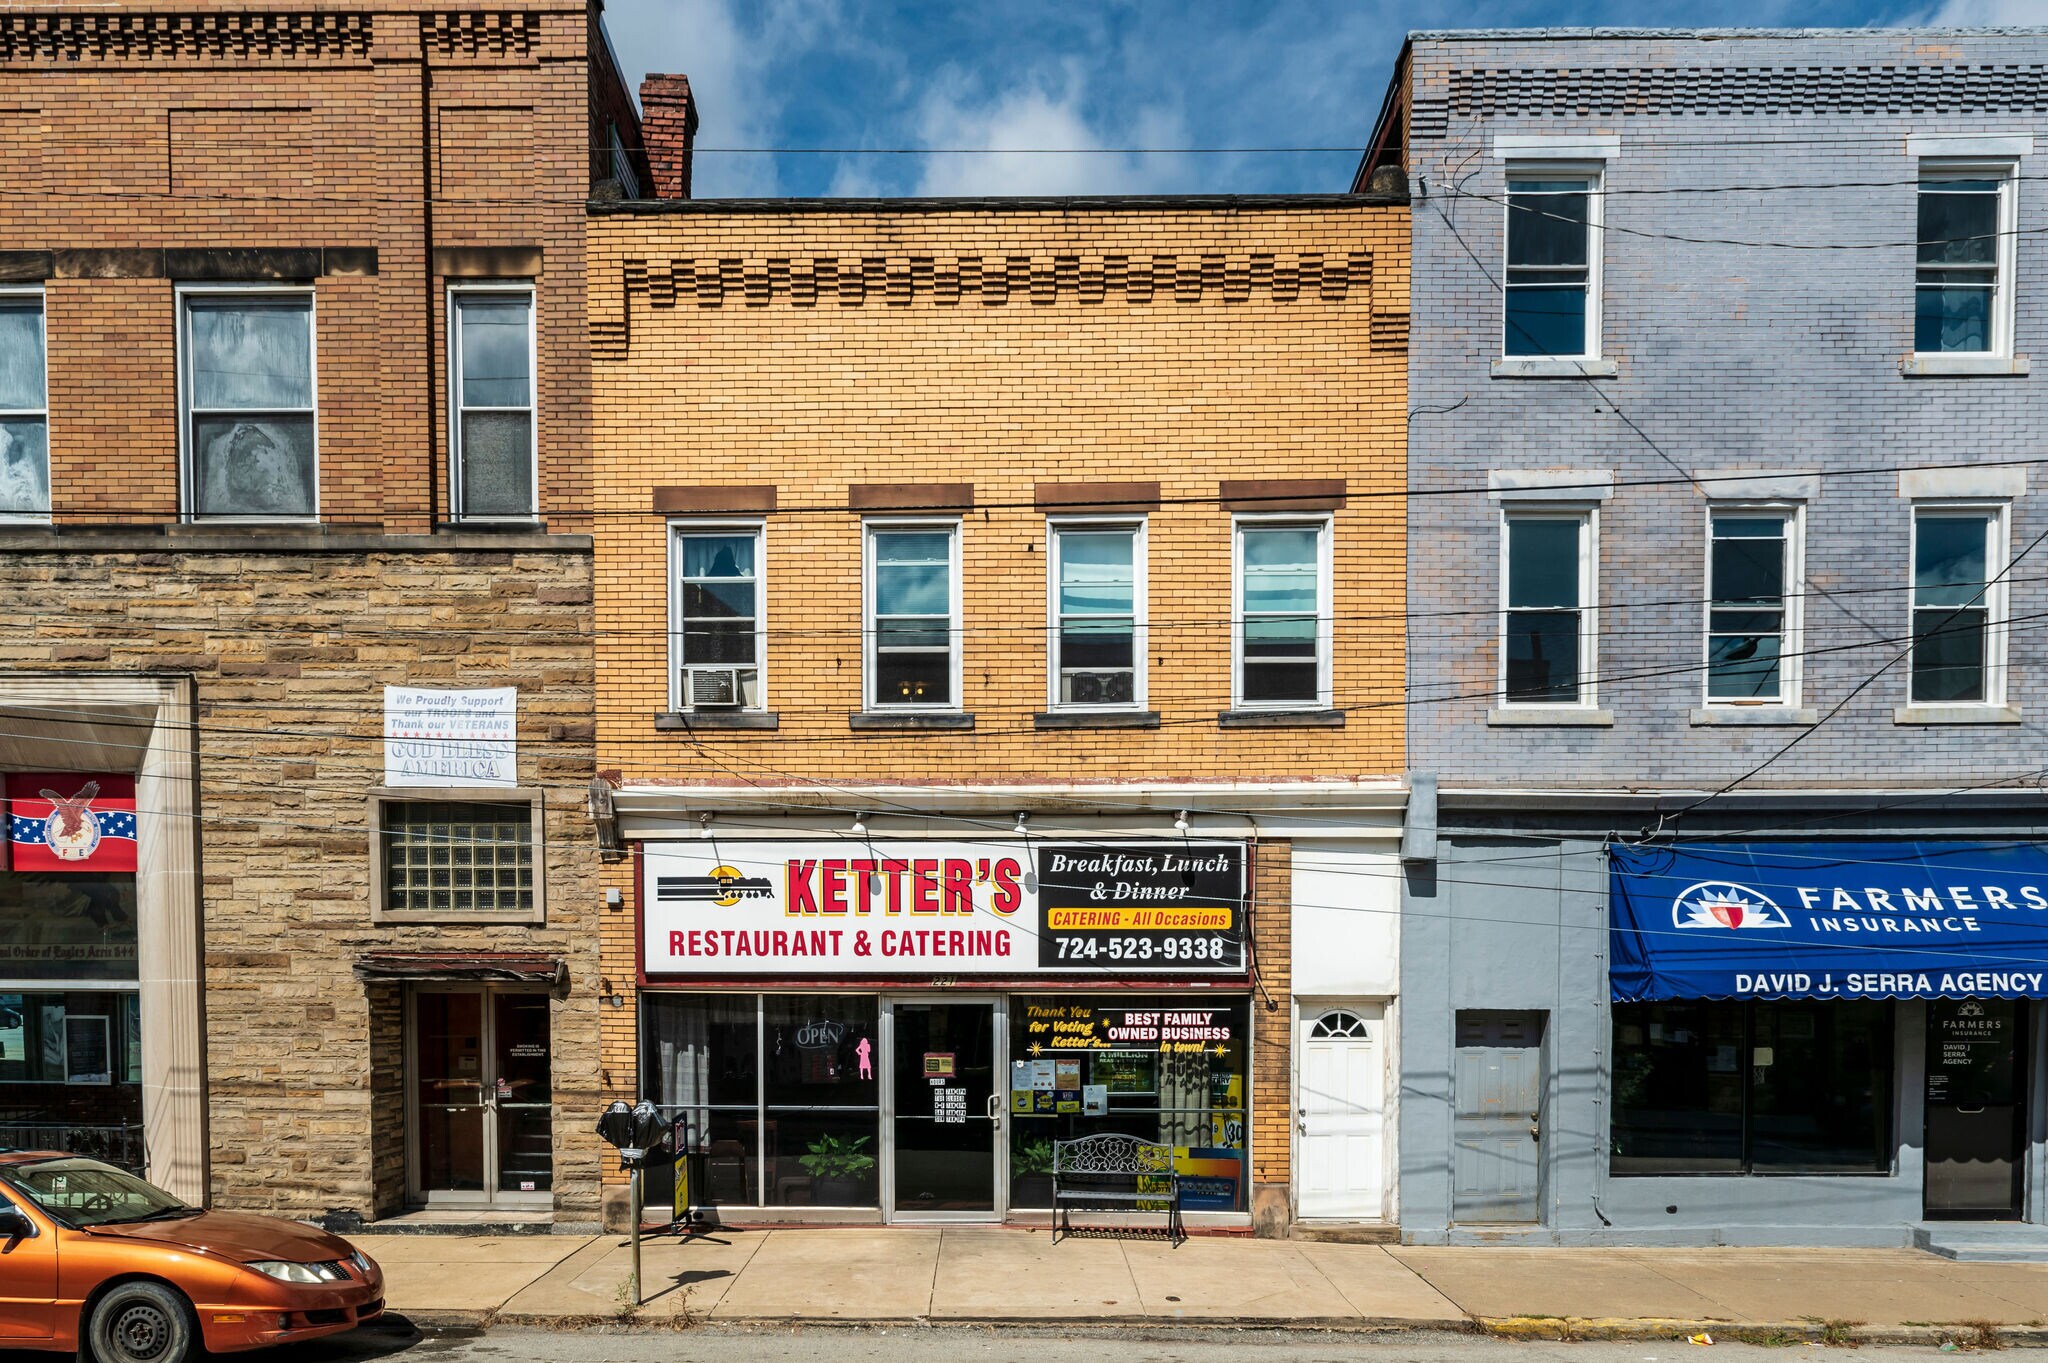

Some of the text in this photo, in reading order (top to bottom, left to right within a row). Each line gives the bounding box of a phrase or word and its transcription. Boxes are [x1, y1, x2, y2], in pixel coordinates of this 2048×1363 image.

[396, 695, 503, 707] We Proudly Support
[427, 709, 472, 718] TROOPS
[475, 709, 495, 718] and
[391, 719, 509, 730] Thank our VETERANS
[392, 741, 509, 759] GOD BLESS
[401, 760, 500, 778] AMERICA
[1050, 853, 1230, 877] Breakfast, Lunch
[785, 858, 1021, 917] KETTER'S
[1090, 881, 1190, 900] & Dinner
[1797, 886, 2048, 911] FARMERS
[1053, 912, 1121, 926] CATERING
[1132, 912, 1152, 926] All
[1154, 912, 1227, 926] Occasions
[1810, 917, 1981, 933] INSURANCE
[669, 930, 1011, 957] RESTAURANT & CATERING
[1055, 937, 1224, 960] 724-523-9338
[1736, 972, 2042, 993] DAVID J. SERRA AGENCY
[1027, 1006, 1091, 1018] Thank You
[1125, 1012, 1213, 1026] BEST FAMILY
[1029, 1021, 1095, 1036] for Voting
[1942, 1020, 2001, 1029] FARMERS
[797, 1027, 839, 1045] OPEN
[1107, 1027, 1230, 1040] OWNED BUSINESS
[1160, 1040, 1206, 1053] in town!
